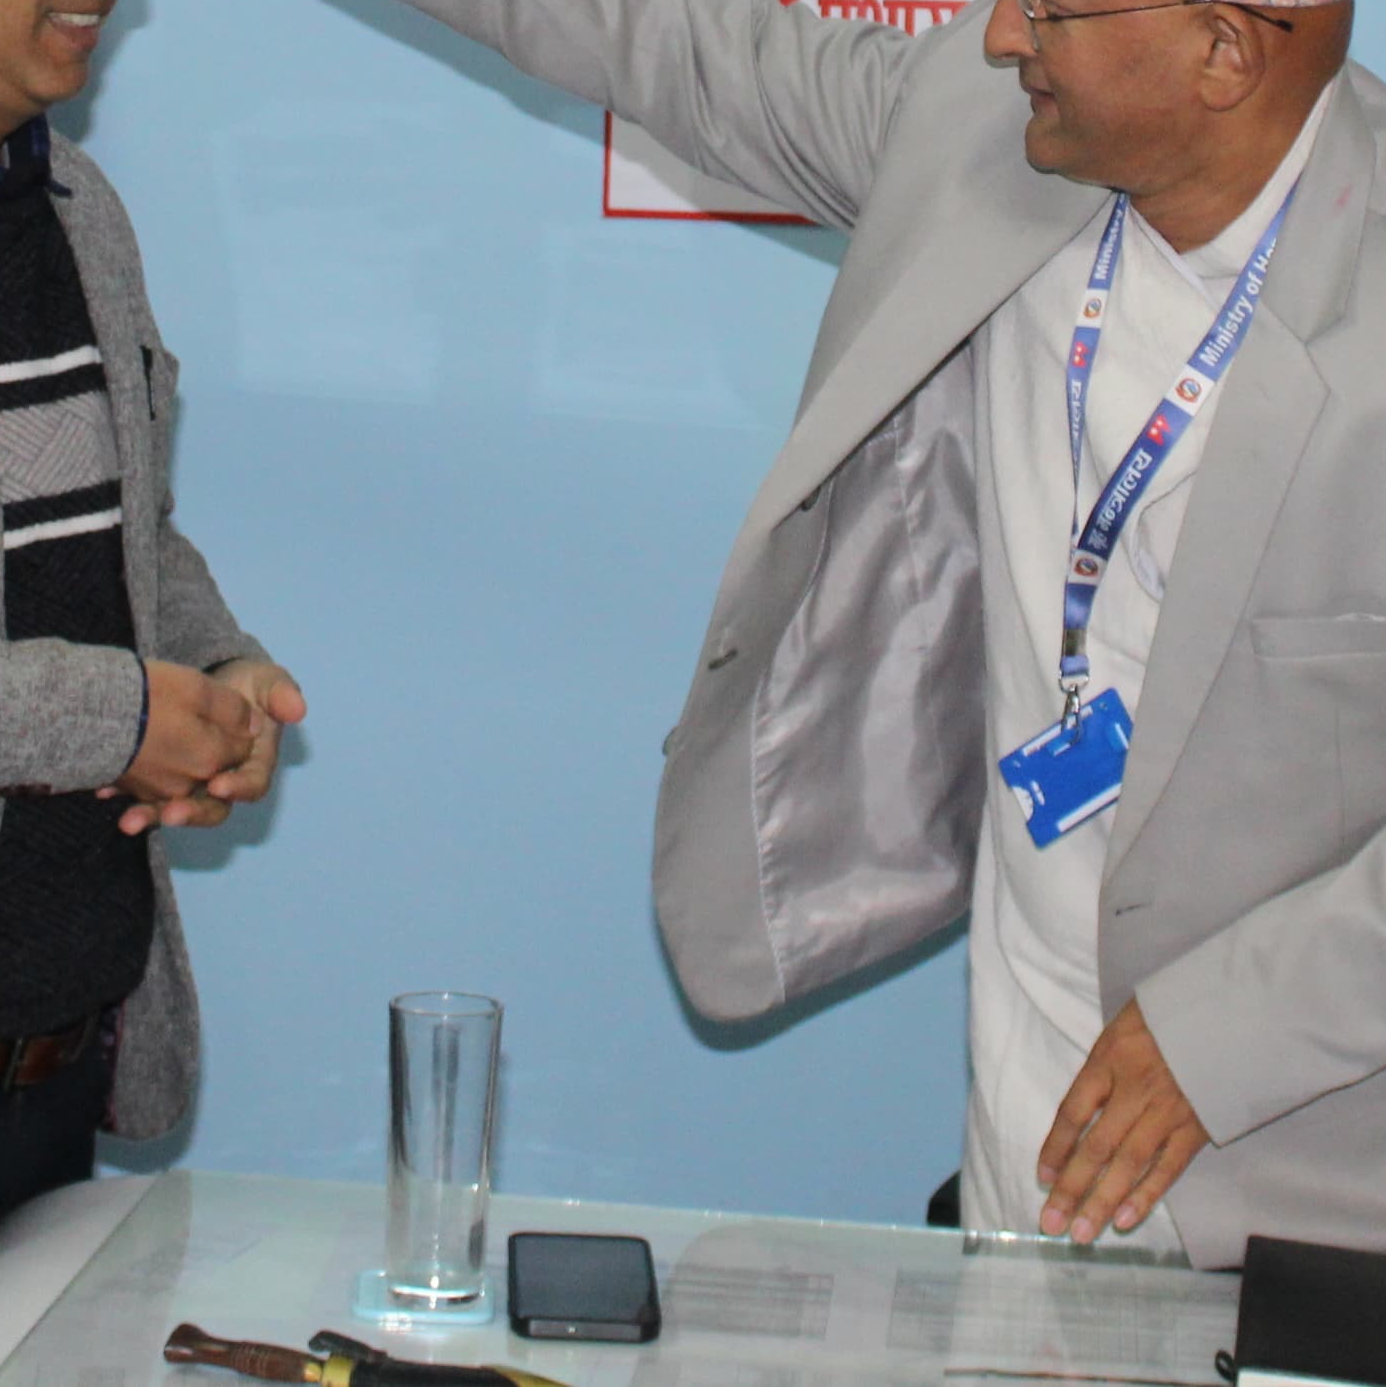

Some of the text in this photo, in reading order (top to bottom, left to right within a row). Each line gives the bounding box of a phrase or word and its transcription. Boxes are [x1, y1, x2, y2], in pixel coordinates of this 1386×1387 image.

[1198, 294, 1254, 367] Ministry
[1245, 270, 1265, 296] of
[1095, 447, 1153, 527] मन्त्रालय
